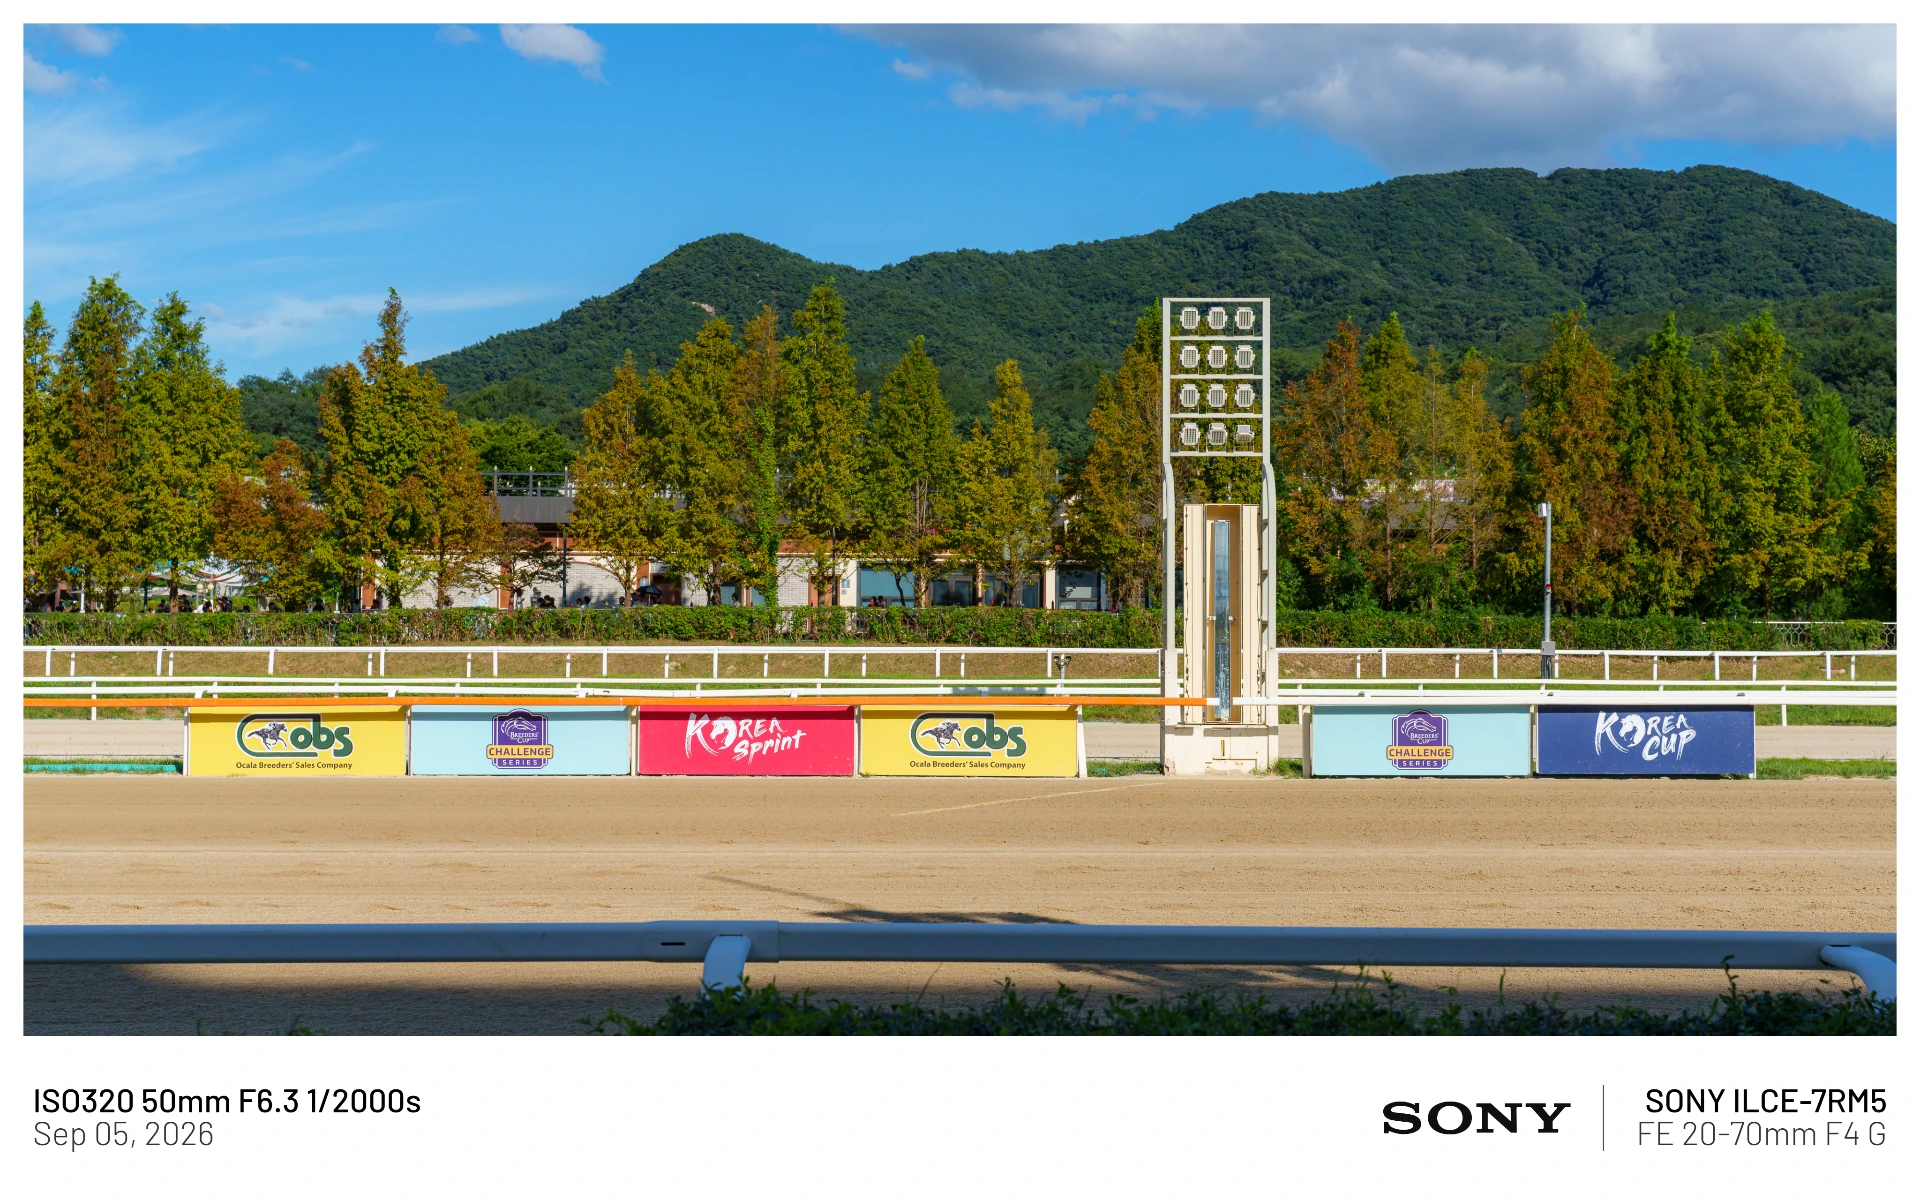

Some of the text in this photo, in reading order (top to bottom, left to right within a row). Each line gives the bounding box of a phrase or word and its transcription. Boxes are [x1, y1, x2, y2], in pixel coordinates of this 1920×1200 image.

[290, 713, 353, 757] obs
[732, 729, 807, 765] Sprint
[963, 712, 1026, 757] obs
[1642, 729, 1696, 761] CUP
[489, 748, 550, 756] CHALLENGE
[1389, 749, 1450, 757] CHALLENGE
